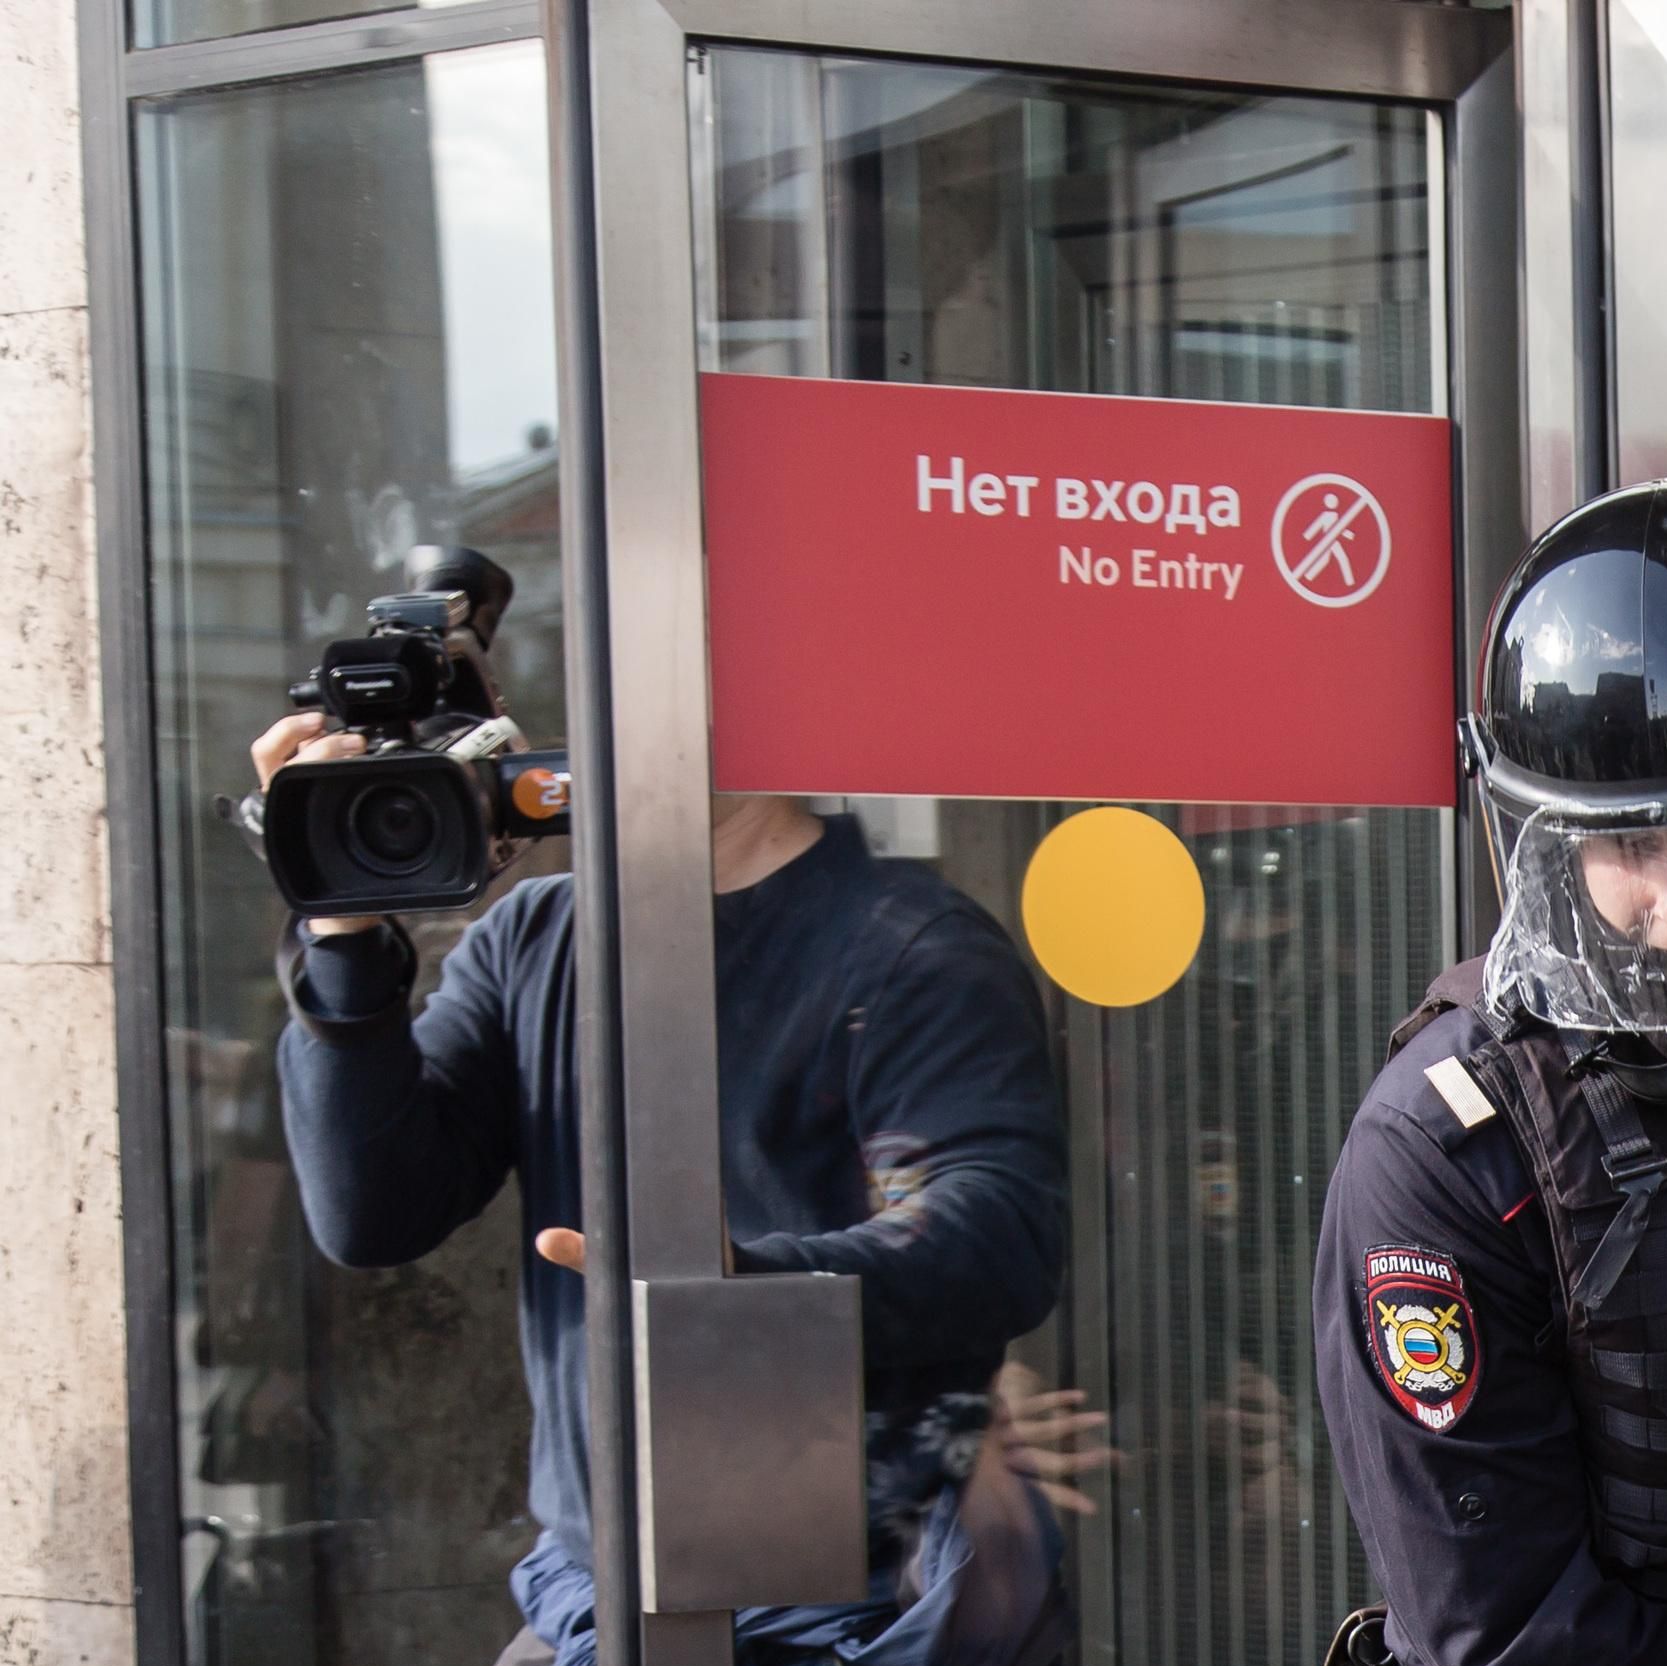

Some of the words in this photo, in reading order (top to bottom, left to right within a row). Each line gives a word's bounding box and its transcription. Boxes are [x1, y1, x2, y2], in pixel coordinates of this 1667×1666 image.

[917, 454, 1040, 518] Нет
[1055, 477, 1242, 535] входа
[1059, 544, 1121, 587] No
[1131, 548, 1244, 600] Entry
[1370, 1255, 1452, 1282] ПОЛИЦИЯ
[1416, 1400, 1455, 1429] МВД
